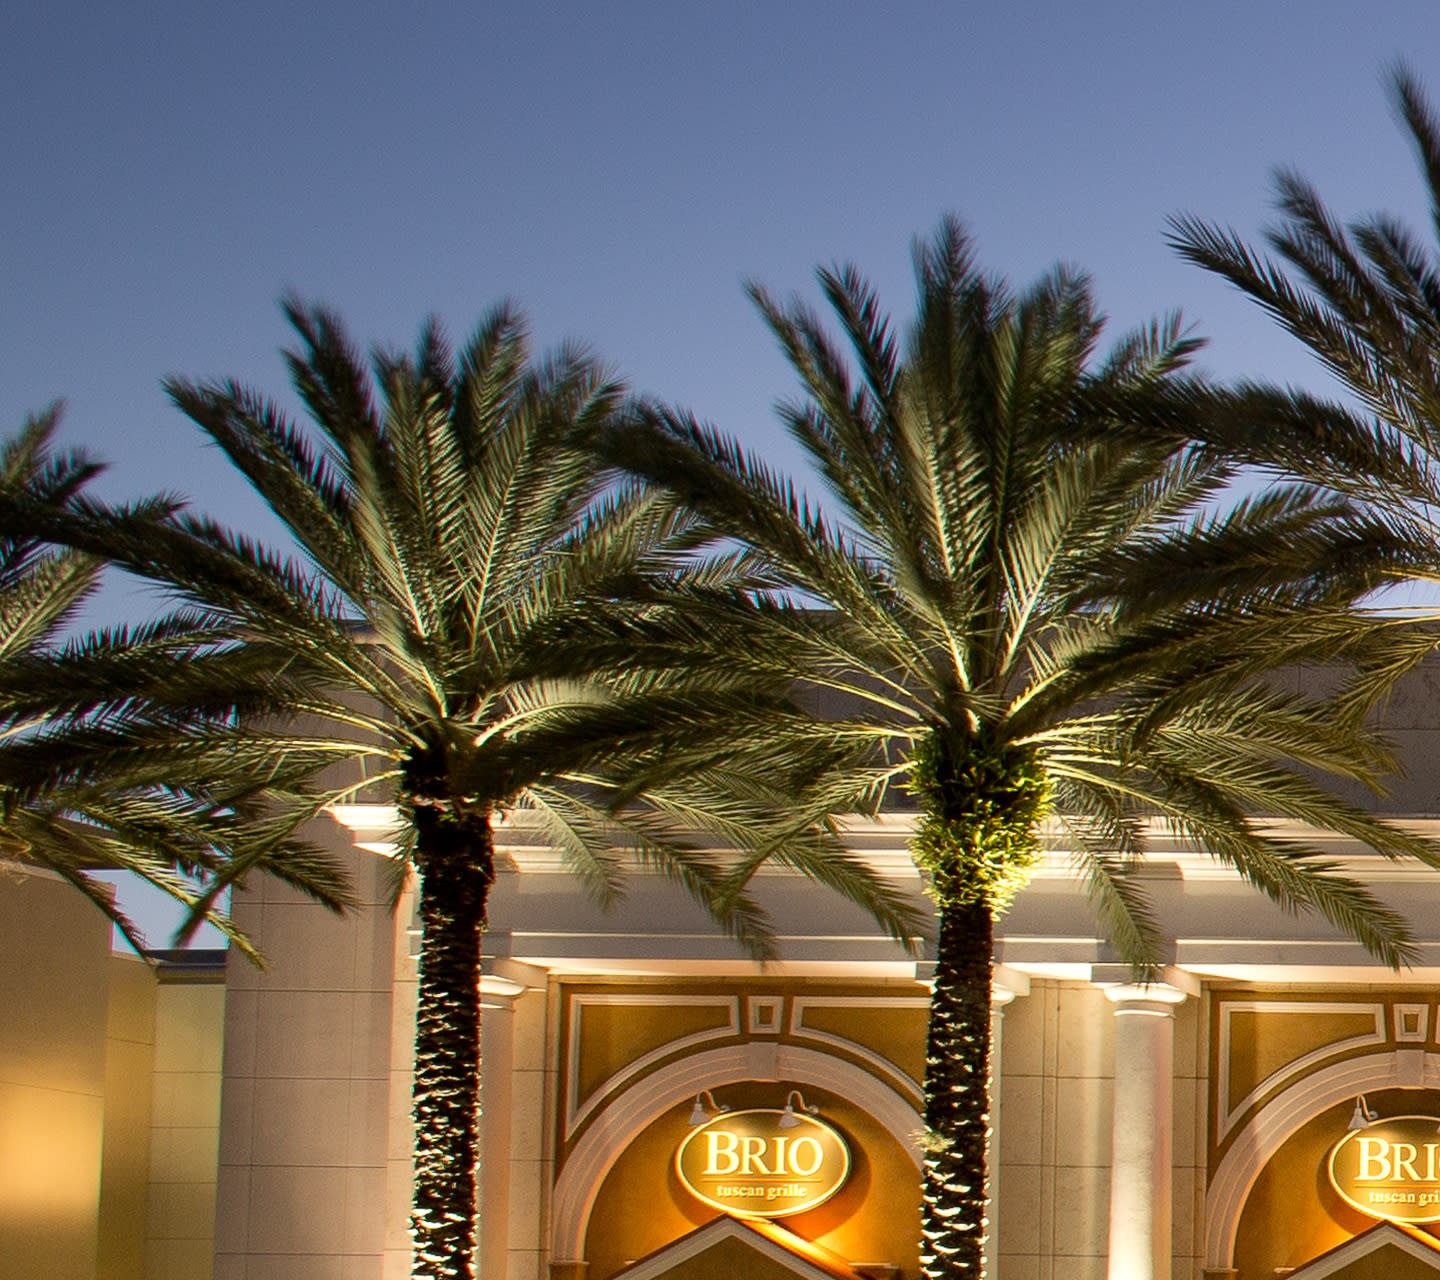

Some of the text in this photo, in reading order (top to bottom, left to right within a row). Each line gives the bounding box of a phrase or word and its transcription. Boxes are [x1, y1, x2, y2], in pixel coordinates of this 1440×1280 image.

[702, 1131, 824, 1176] BRIO
[717, 1183, 809, 1200] tuscan grille
[1369, 1190, 1416, 1204] tuscan
